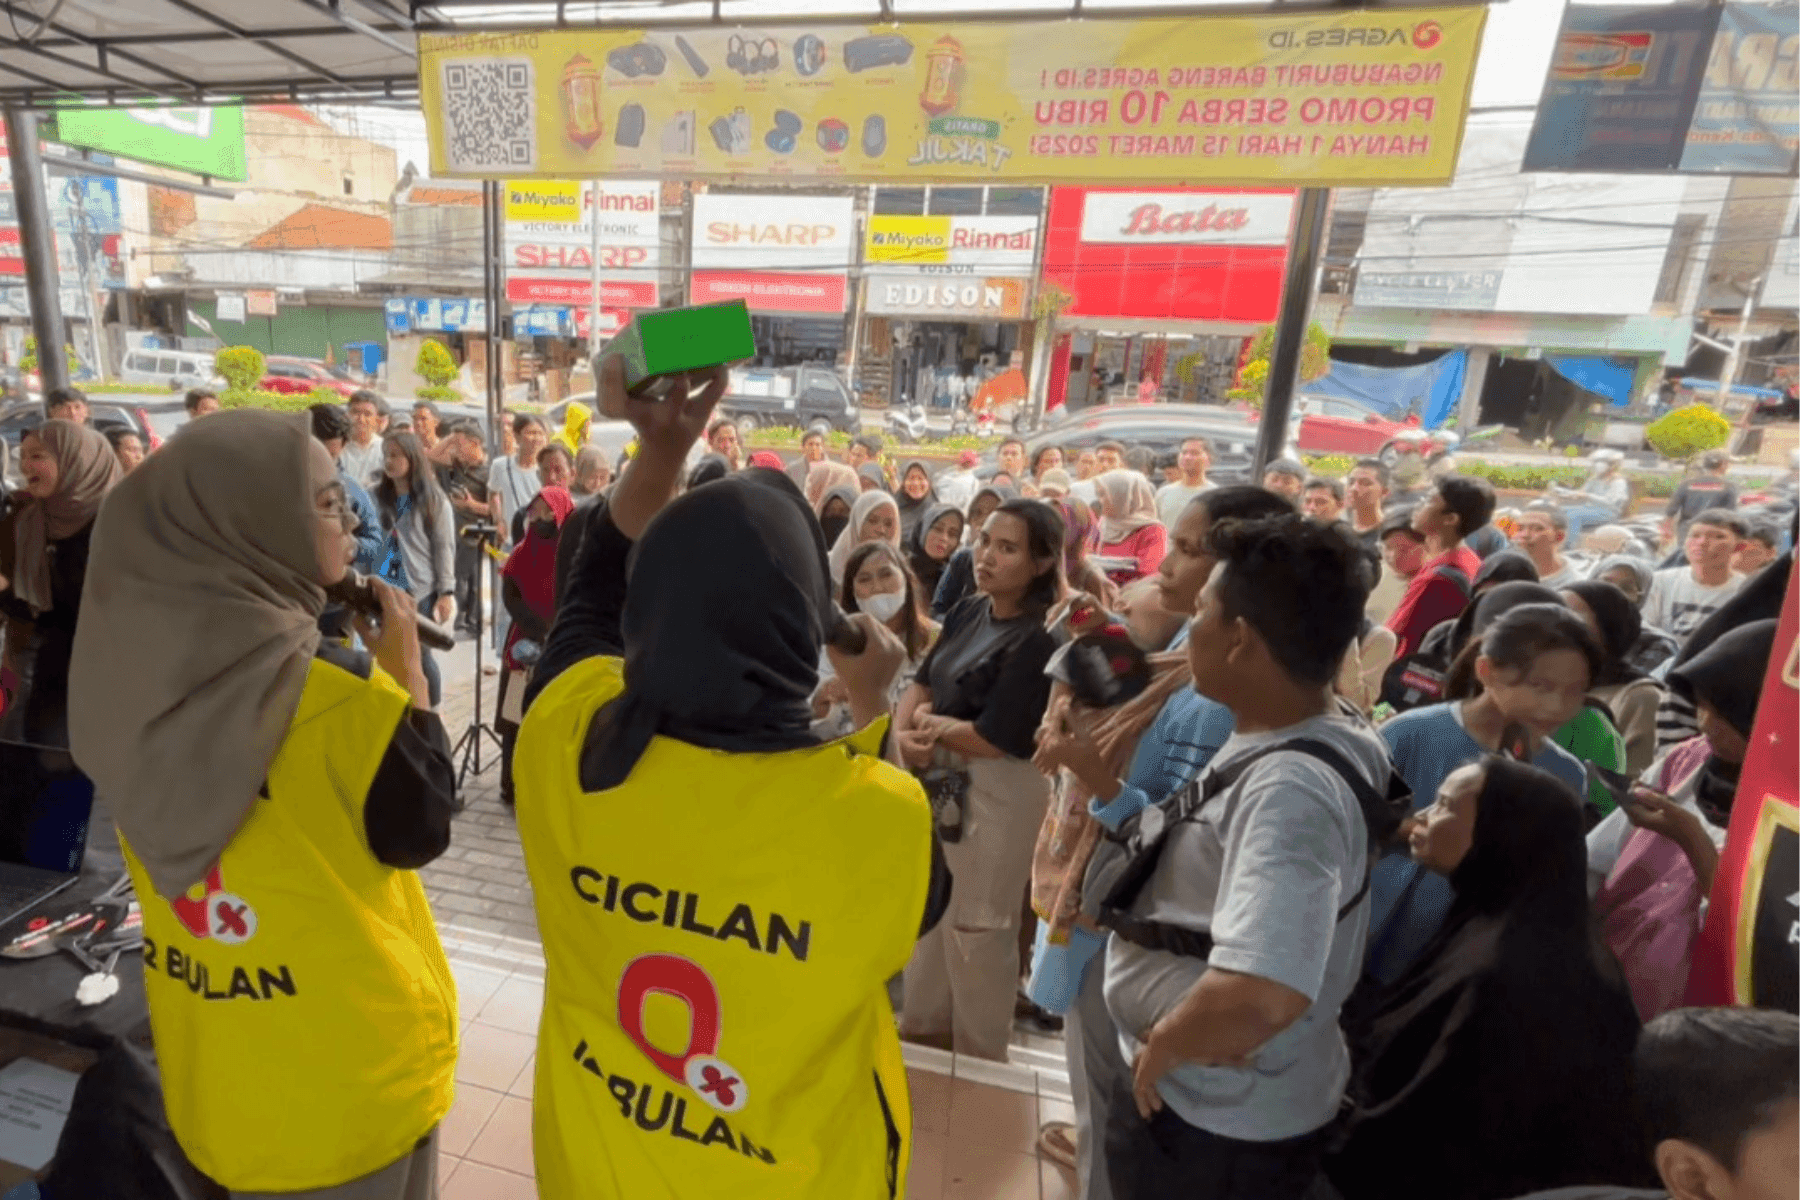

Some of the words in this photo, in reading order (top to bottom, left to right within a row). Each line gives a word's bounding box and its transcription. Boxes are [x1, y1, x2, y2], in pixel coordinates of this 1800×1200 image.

[523, 190, 576, 211] Miyako
[584, 190, 655, 212] Rinnai
[523, 222, 567, 233] VICTORY
[1120, 202, 1250, 236] Bata
[705, 220, 837, 246] SHARP
[886, 232, 944, 250] Miyako
[952, 227, 1033, 251] Rinnai
[515, 244, 648, 269] SHARP
[919, 263, 975, 275] EDISON
[885, 284, 1004, 308] EDISON
[570, 865, 812, 962] CICILAN
[166, 944, 298, 1001] BULAN
